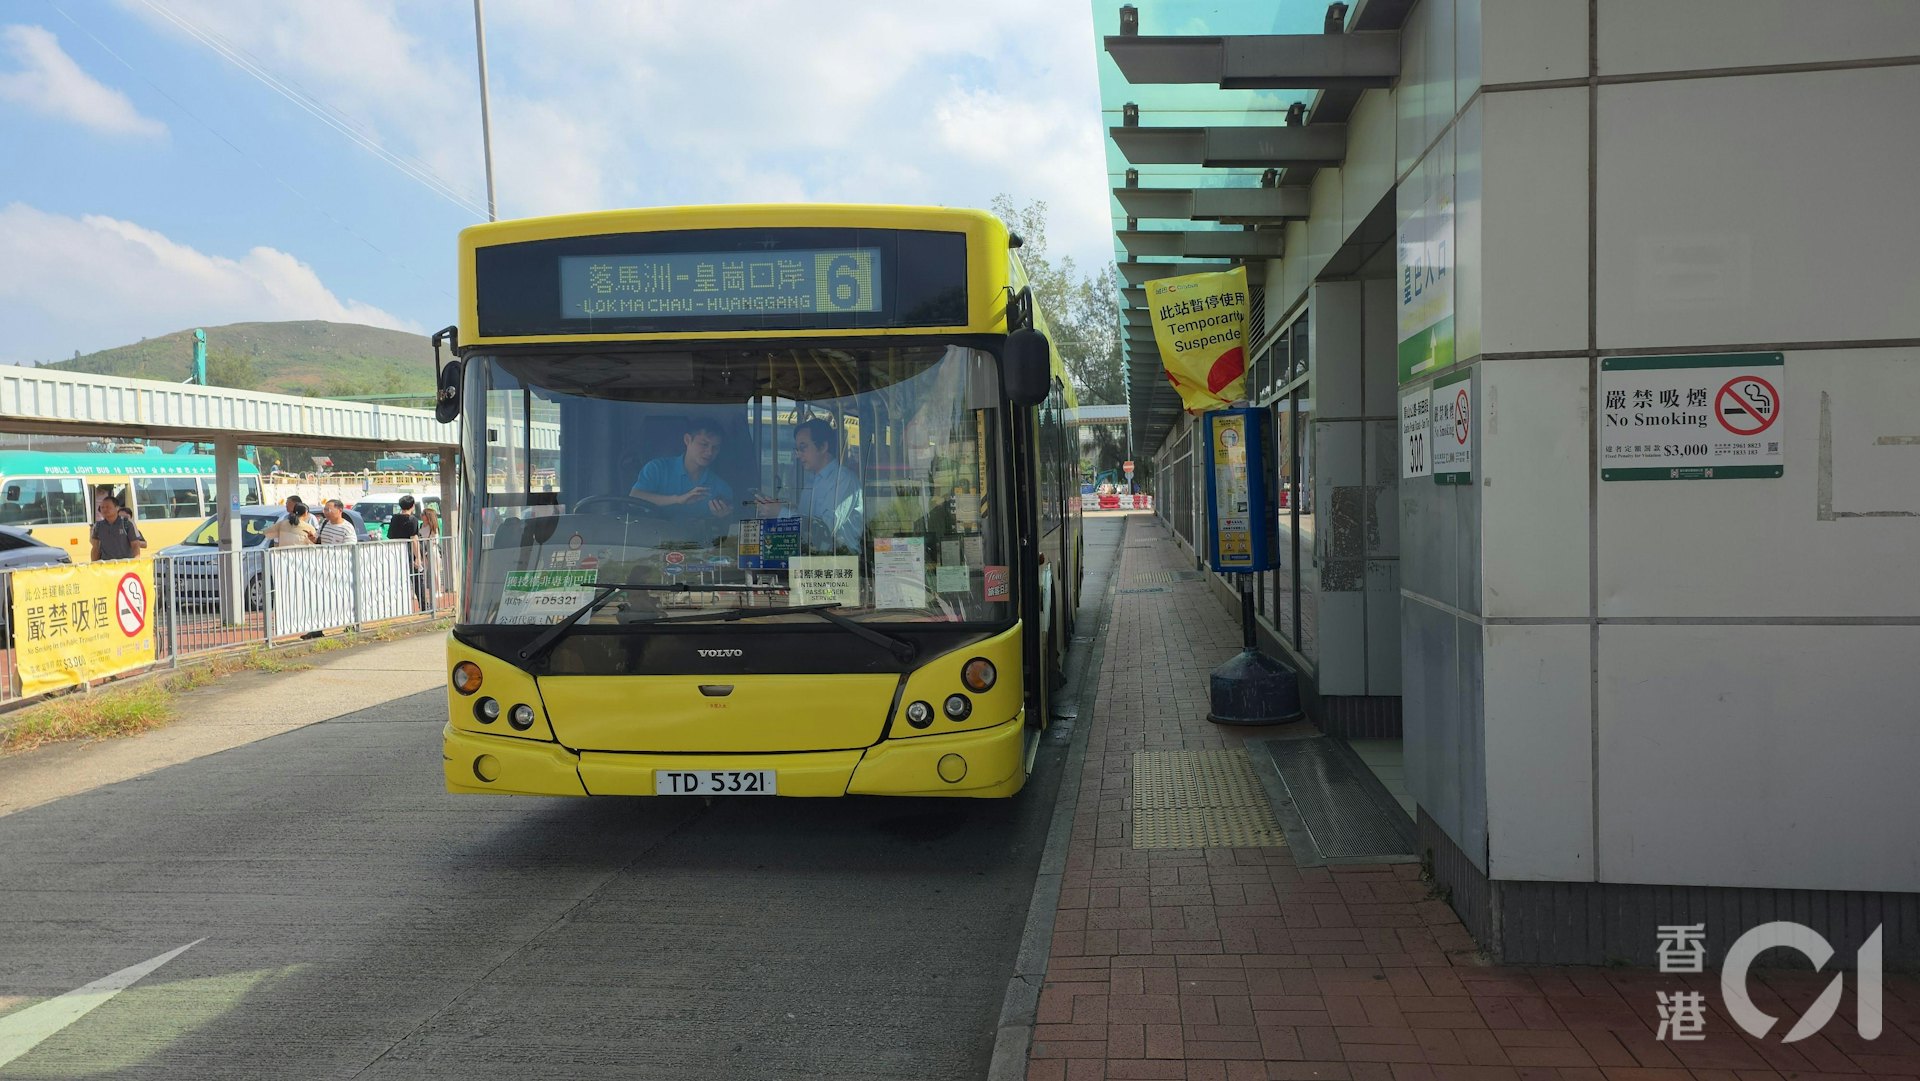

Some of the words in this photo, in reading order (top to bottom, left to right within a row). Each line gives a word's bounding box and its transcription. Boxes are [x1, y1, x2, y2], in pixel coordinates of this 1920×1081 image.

[827, 255, 861, 309] 6
[584, 299, 617, 313] LOK
[620, 299, 644, 312] MA
[1160, 292, 1245, 321] 此站暫停使用
[1174, 329, 1241, 353] Suspende
[1605, 388, 1708, 410] 嚴禁吸煙
[1606, 413, 1629, 427] No
[1634, 412, 1708, 428] Smoking
[1410, 433, 1424, 473] 300
[1664, 443, 1709, 458] $3,000
[44, 466, 70, 474] PUBLIC
[74, 466, 93, 474] LIGHT
[96, 466, 110, 474] BUS
[793, 568, 854, 579] 國際乘客服務
[534, 595, 578, 605] TD5321
[26, 596, 110, 643] 嚴禁吸煙
[697, 649, 743, 657] VOLVO
[667, 773, 699, 793] TD
[711, 772, 765, 792] 5321
